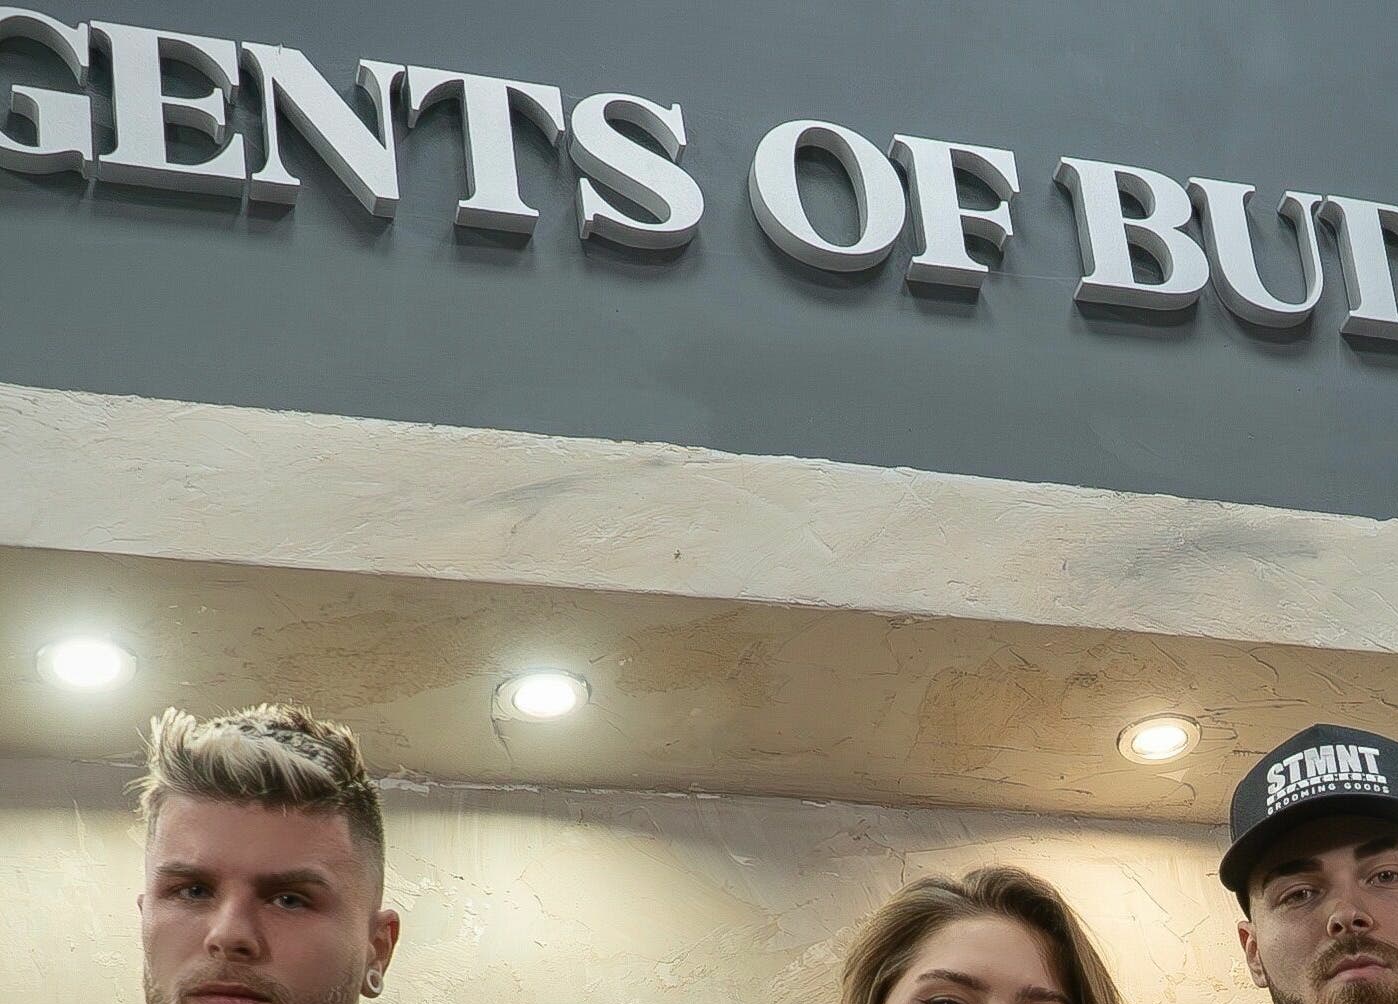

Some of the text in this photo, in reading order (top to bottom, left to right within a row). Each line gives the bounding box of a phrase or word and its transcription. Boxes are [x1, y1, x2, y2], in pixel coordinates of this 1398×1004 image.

[0, 6, 705, 250] GENTS
[748, 119, 1021, 290] OF
[1266, 743, 1381, 795] STMNT
[1266, 782, 1337, 816] GROOMING
[1343, 781, 1391, 794] GOODS
